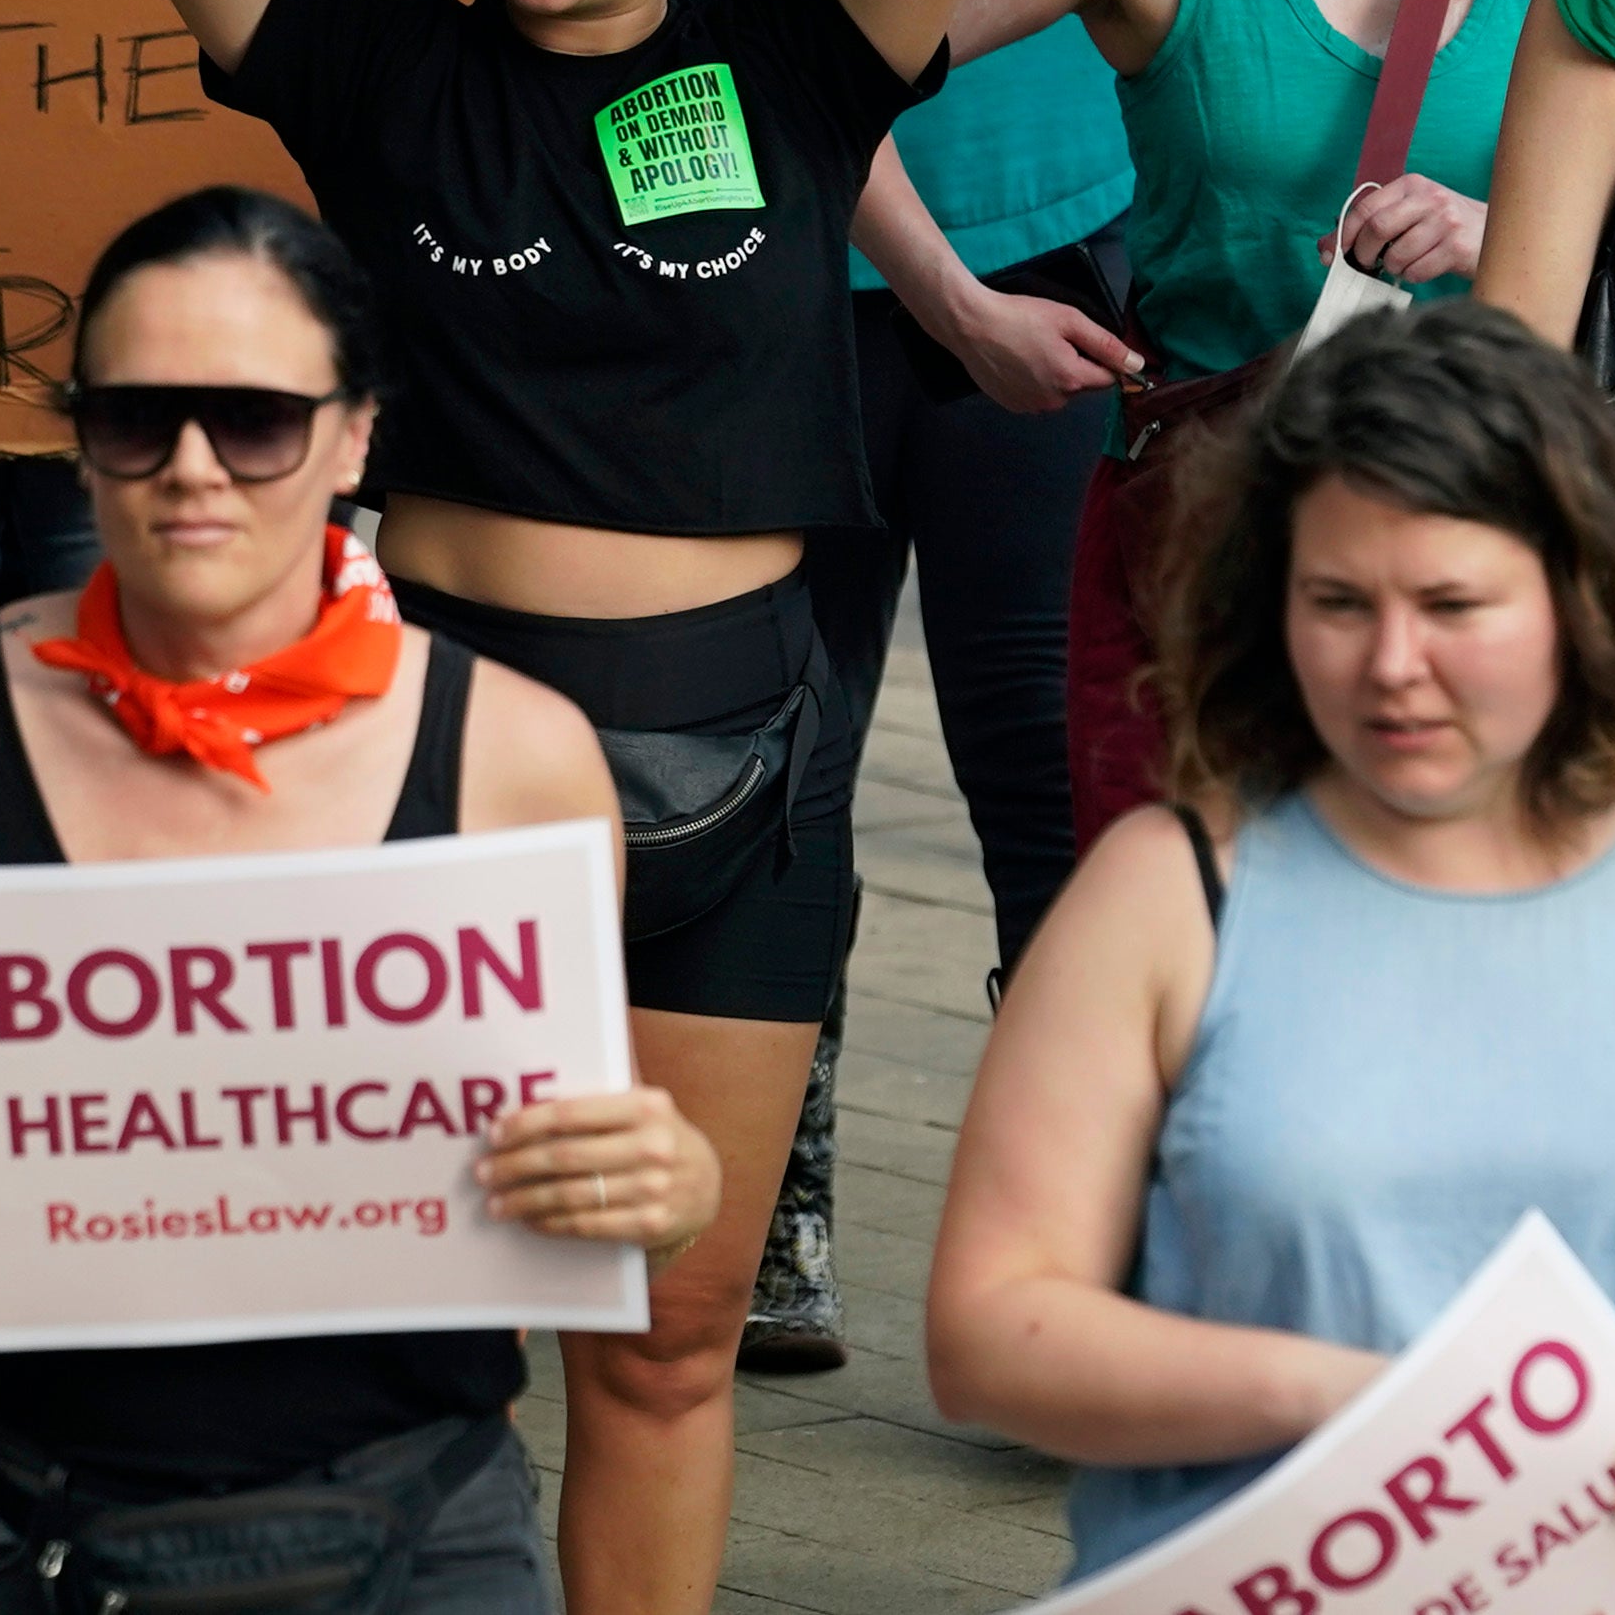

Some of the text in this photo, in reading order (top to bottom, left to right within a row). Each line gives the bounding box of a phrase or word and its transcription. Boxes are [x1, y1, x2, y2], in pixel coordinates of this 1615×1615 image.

[609, 69, 722, 127] ABORTION
[615, 99, 726, 143] ON DEMAND
[617, 124, 730, 168] & WITHOUT
[629, 151, 741, 195] APOLOGY!
[412, 222, 553, 277] IT'S MY BODY
[612, 226, 767, 280] IT'S MY CHOICE
[44, 1192, 451, 1249] RosiesLaw.org
